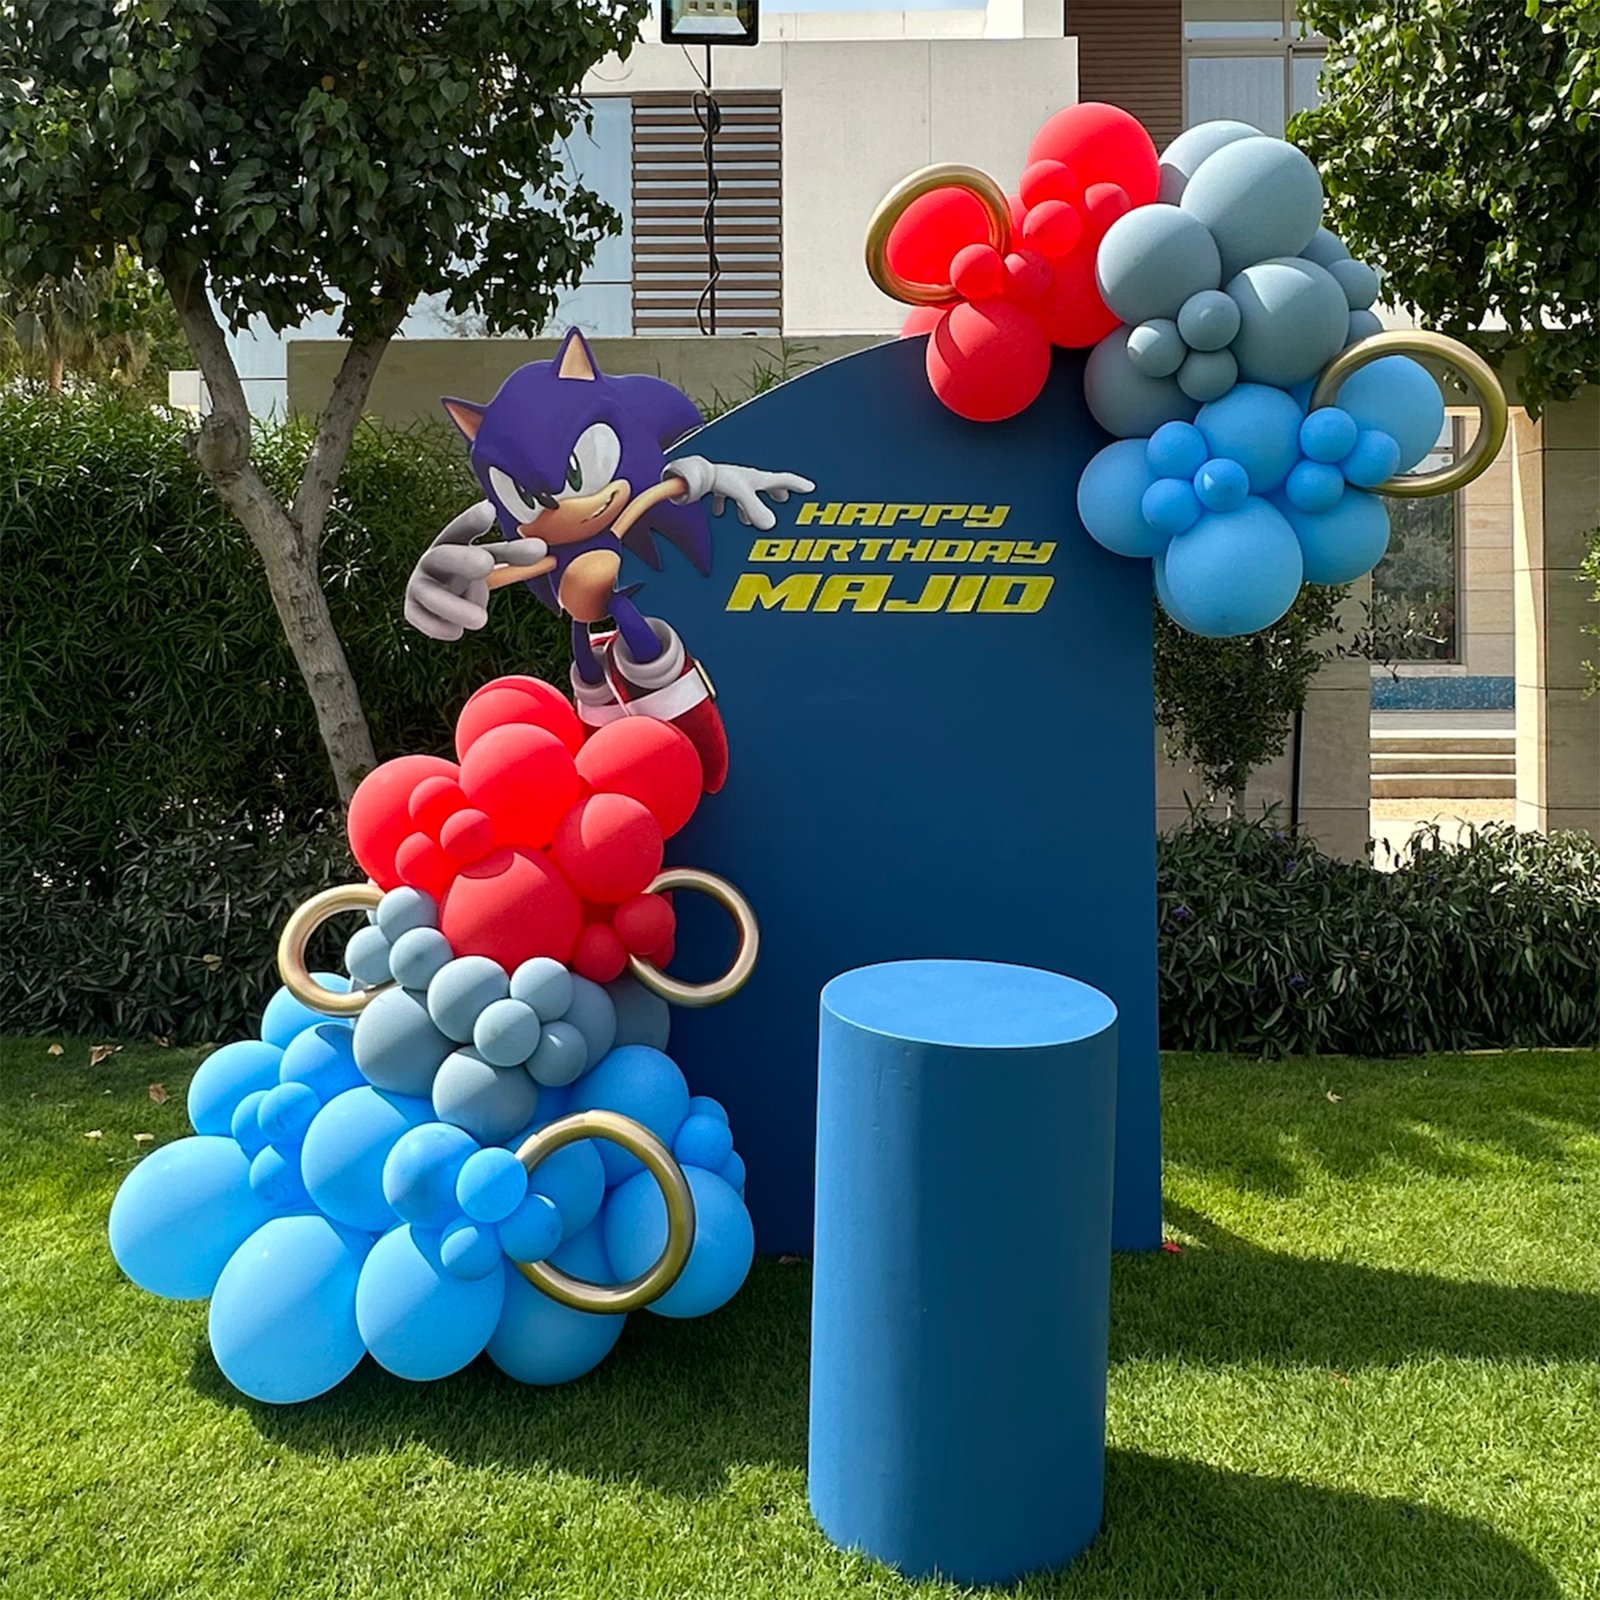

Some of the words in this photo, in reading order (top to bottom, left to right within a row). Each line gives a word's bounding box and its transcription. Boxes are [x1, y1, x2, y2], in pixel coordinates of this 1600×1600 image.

[796, 502, 1010, 528] HAPPY
[749, 538, 1057, 564] BIRTHDAY
[725, 573, 1056, 613] MAJID
